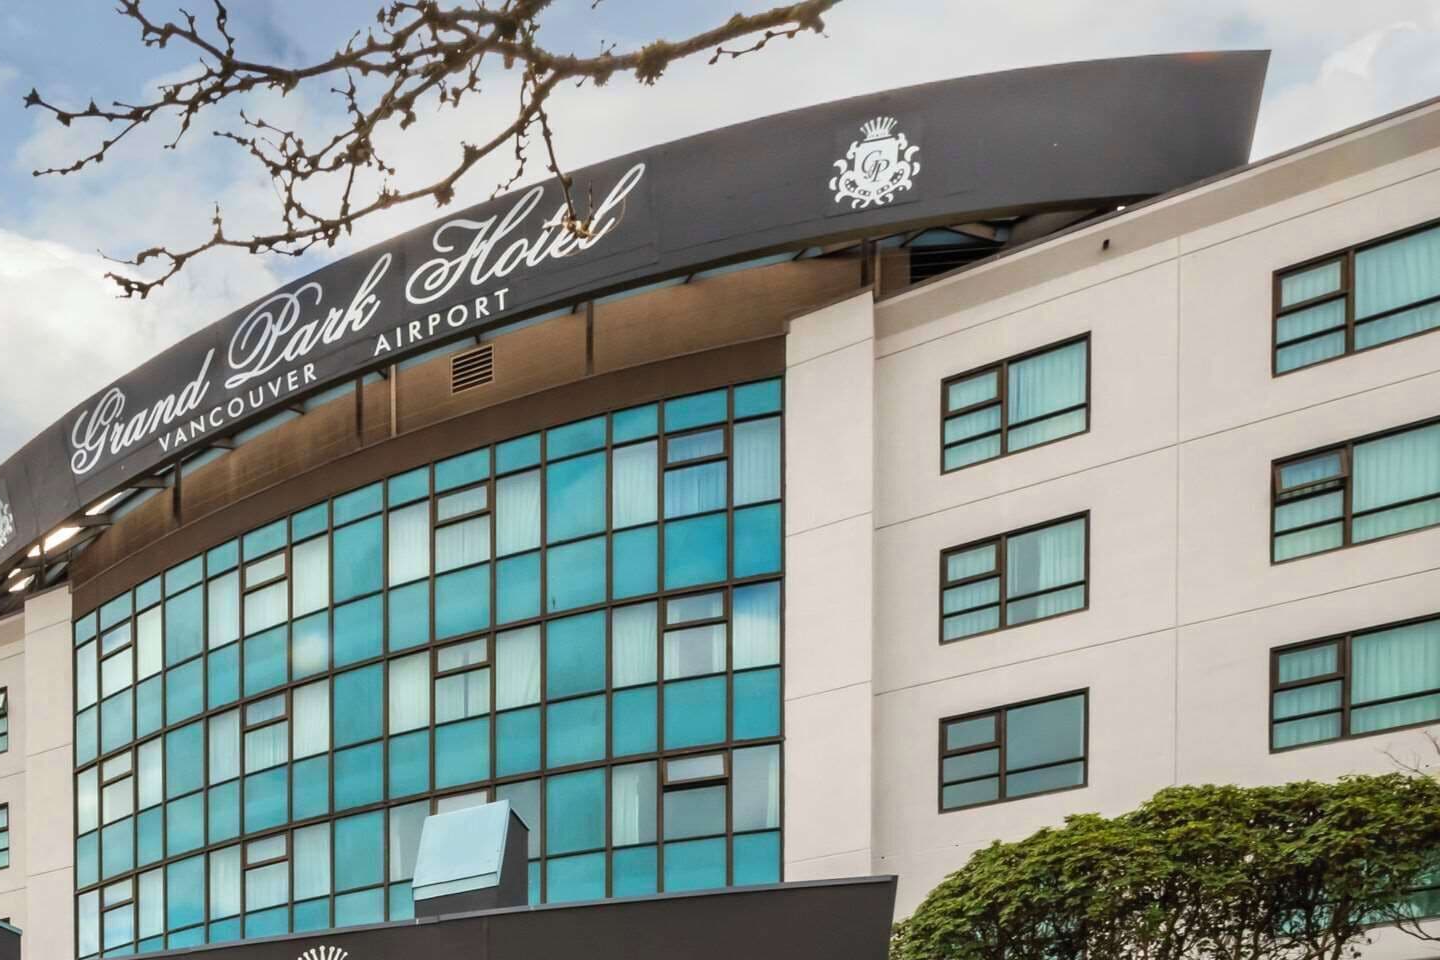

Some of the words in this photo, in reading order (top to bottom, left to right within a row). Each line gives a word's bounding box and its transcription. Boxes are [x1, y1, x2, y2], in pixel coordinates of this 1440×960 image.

[71, 348, 215, 475] Grand
[224, 253, 392, 389] Park
[405, 163, 646, 305] Hotel
[158, 363, 317, 452] VANCOUVER
[373, 287, 509, 357] AIRPORT
